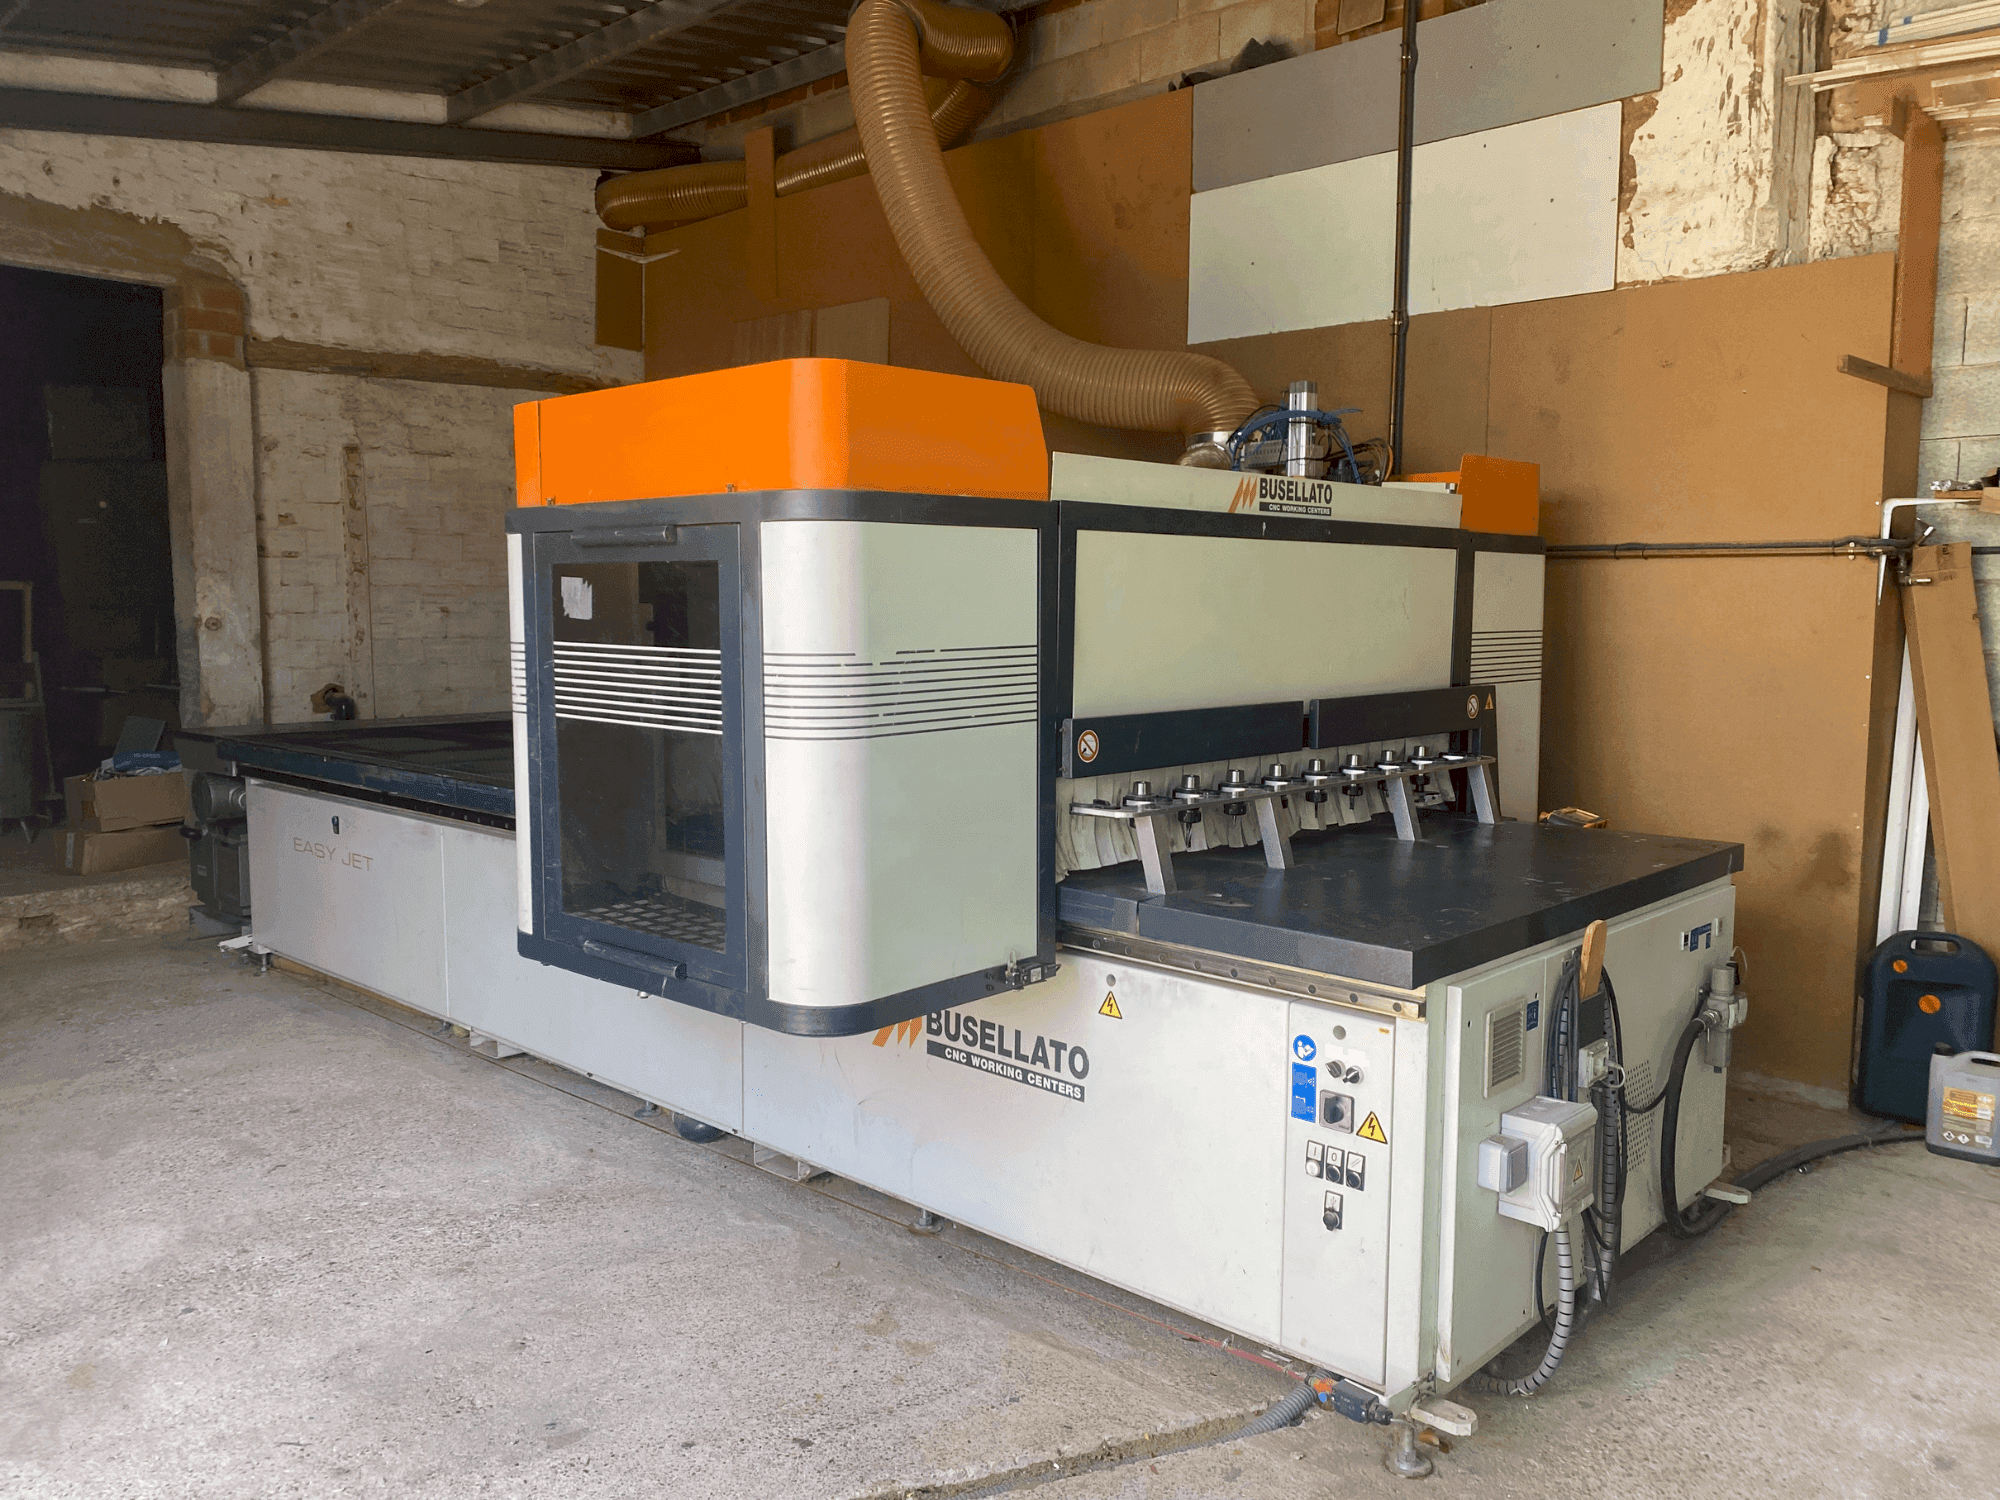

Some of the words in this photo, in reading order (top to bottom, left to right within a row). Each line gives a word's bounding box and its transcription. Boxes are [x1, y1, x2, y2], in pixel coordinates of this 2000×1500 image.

[1259, 478, 1333, 504] BUSELLATO
[1282, 505, 1306, 513] WORKING
[1308, 507, 1330, 515] CENTERS
[293, 837, 337, 861] EASY
[341, 851, 374, 871] JET
[926, 1009, 1090, 1080] BUSELLATO
[944, 1047, 967, 1064] CNC
[970, 1056, 1023, 1081] WORKING
[1027, 1072, 1082, 1099] CENTERS
